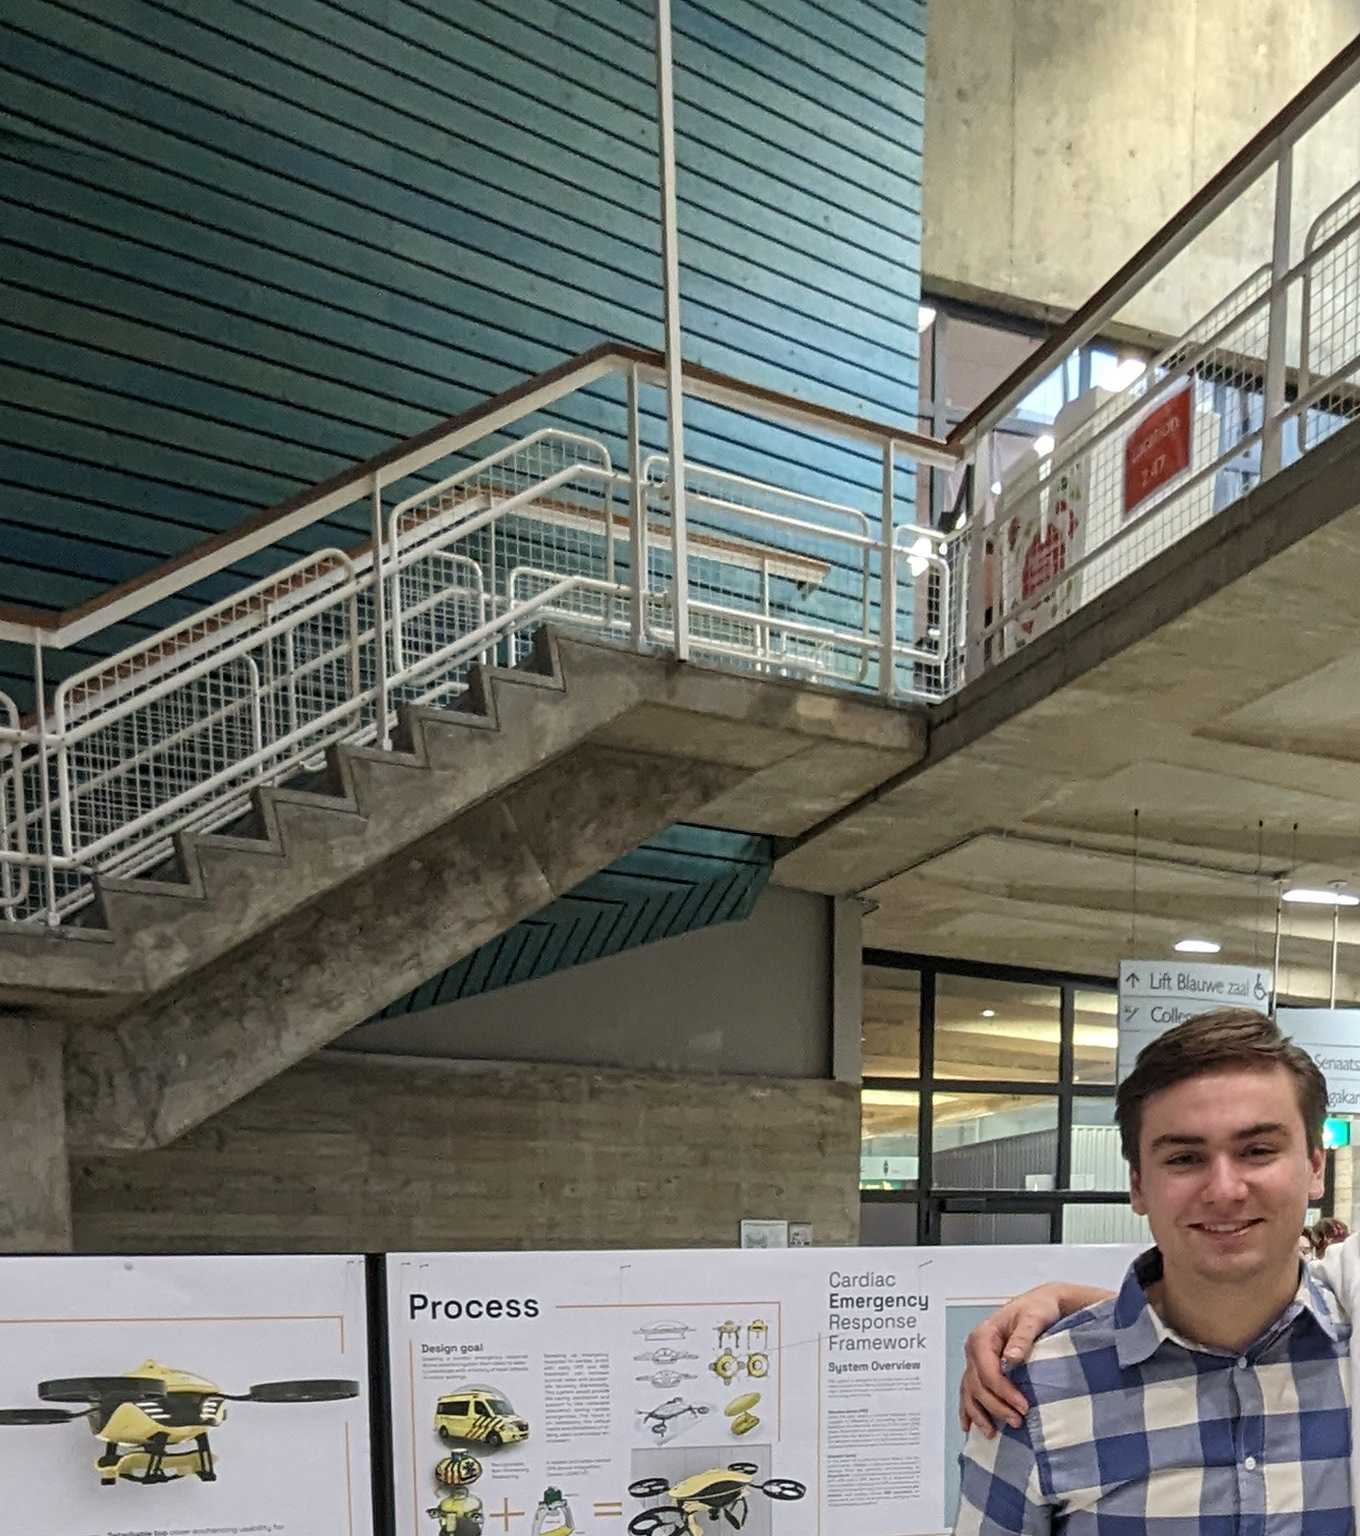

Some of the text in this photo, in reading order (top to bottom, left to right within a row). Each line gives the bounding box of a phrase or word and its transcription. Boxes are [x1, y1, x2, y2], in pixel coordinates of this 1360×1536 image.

[1150, 972, 1249, 997] Lift Blauwe zaal
[828, 1271, 896, 1288] Cardiac
[409, 1294, 540, 1320] Process
[828, 1293, 930, 1311] Emergency
[828, 1314, 918, 1333] Response
[421, 1343, 484, 1354] Design goal
[828, 1333, 927, 1352] Framework
[827, 1360, 921, 1374] System Overview
